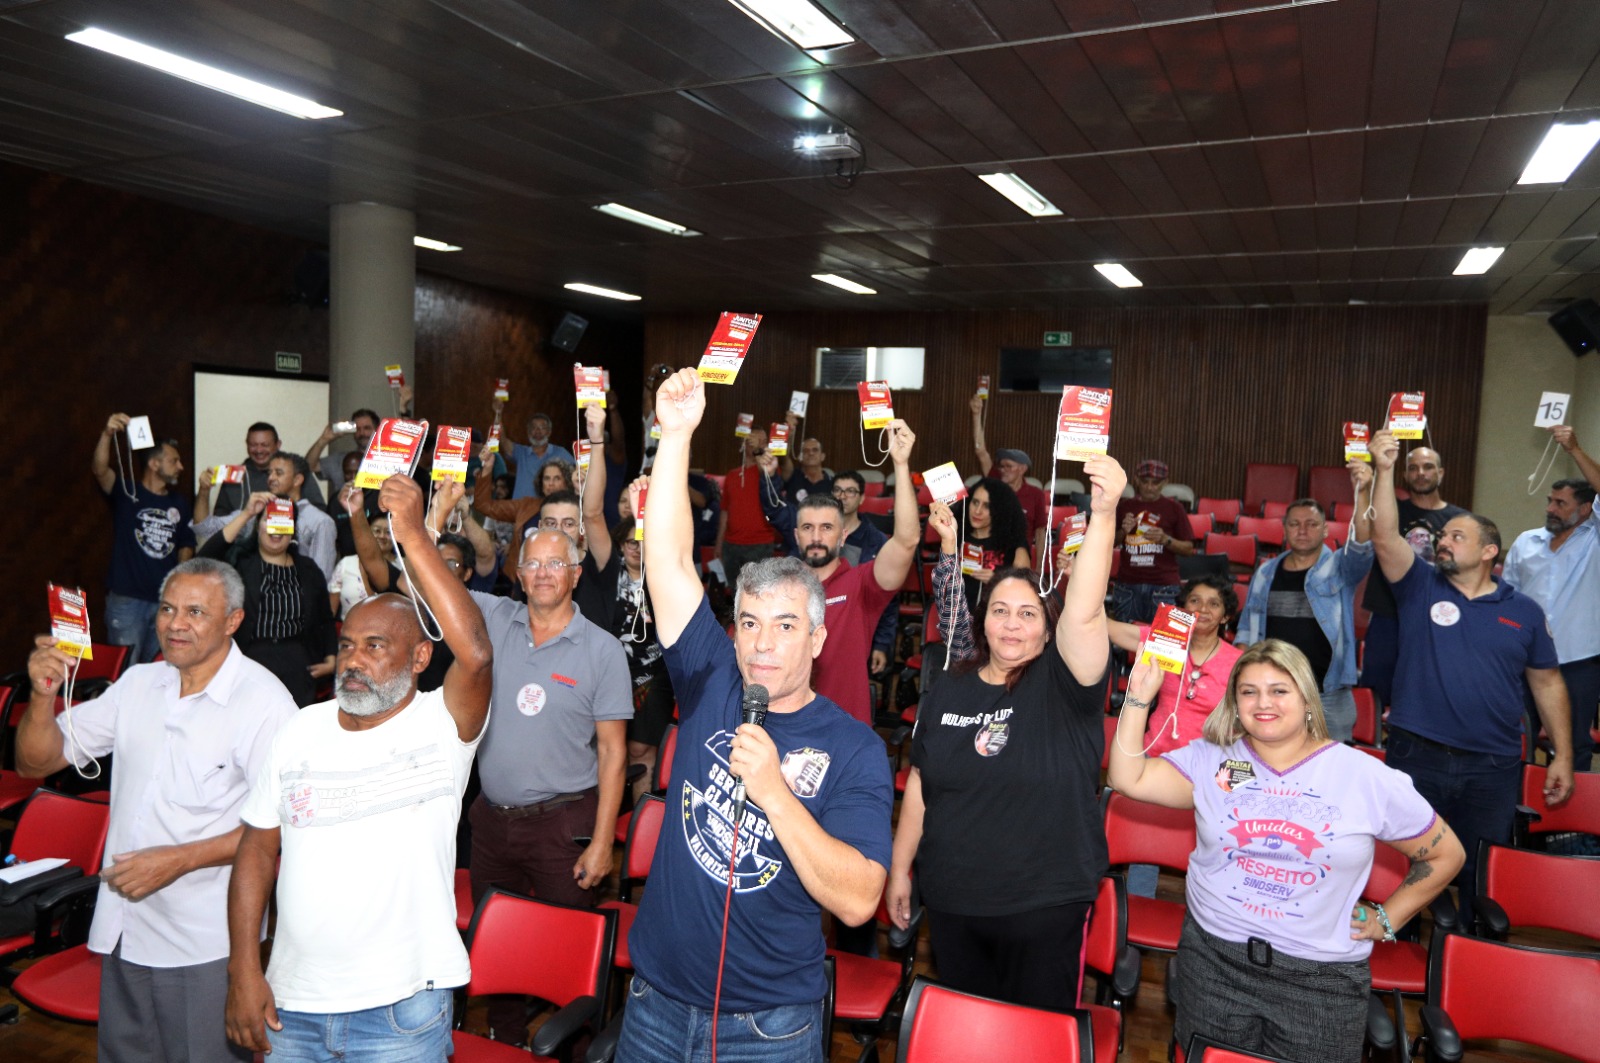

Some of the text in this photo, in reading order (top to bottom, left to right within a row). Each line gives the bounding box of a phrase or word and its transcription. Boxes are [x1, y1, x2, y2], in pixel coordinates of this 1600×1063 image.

[791, 398, 805, 411] 21
[1540, 402, 1564, 420] 15
[138, 427, 146, 441] 4
[1245, 821, 1305, 840] Unidas
[1267, 838, 1280, 846] por
[1237, 856, 1316, 886] RESPEITO
[1243, 877, 1294, 897] SINDSERV
